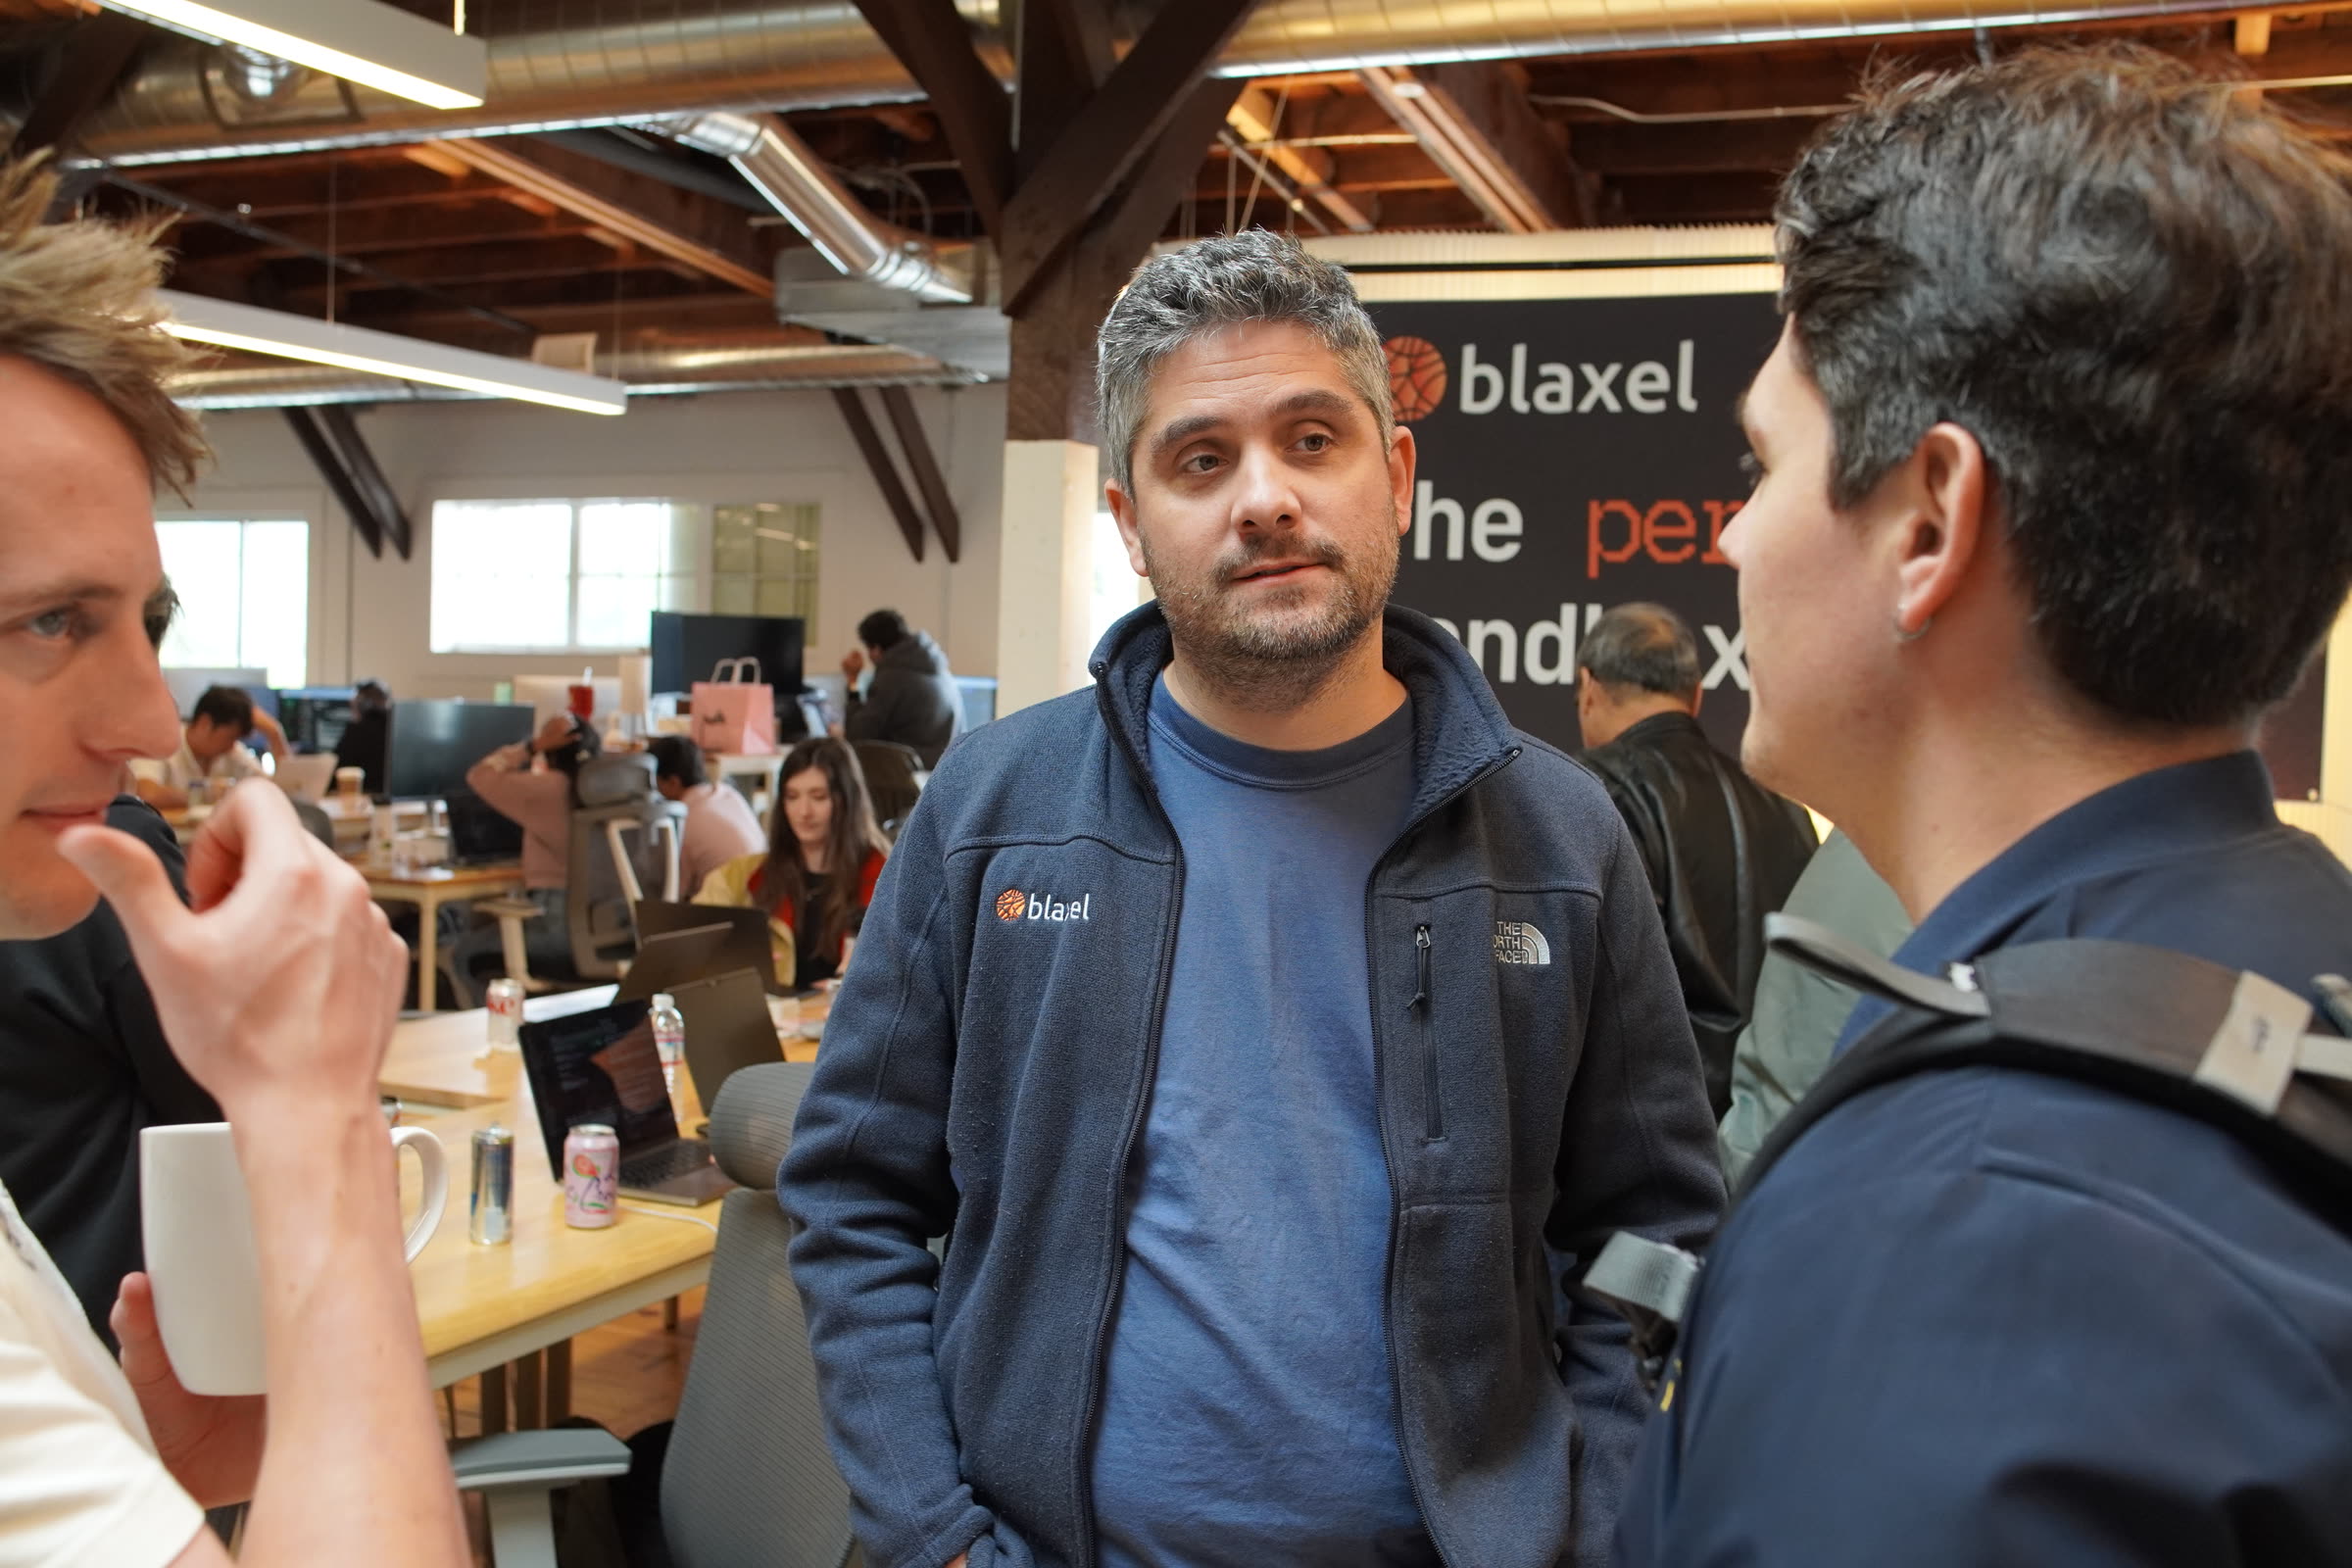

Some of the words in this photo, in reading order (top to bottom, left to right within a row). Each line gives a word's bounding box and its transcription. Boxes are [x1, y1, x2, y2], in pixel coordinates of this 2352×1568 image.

[1459, 339, 1698, 416] blaxel
[1413, 479, 1524, 563] he
[1587, 499, 1746, 579] per
[1493, 934, 1521, 950] ORTH
[1496, 921, 1522, 935] THE
